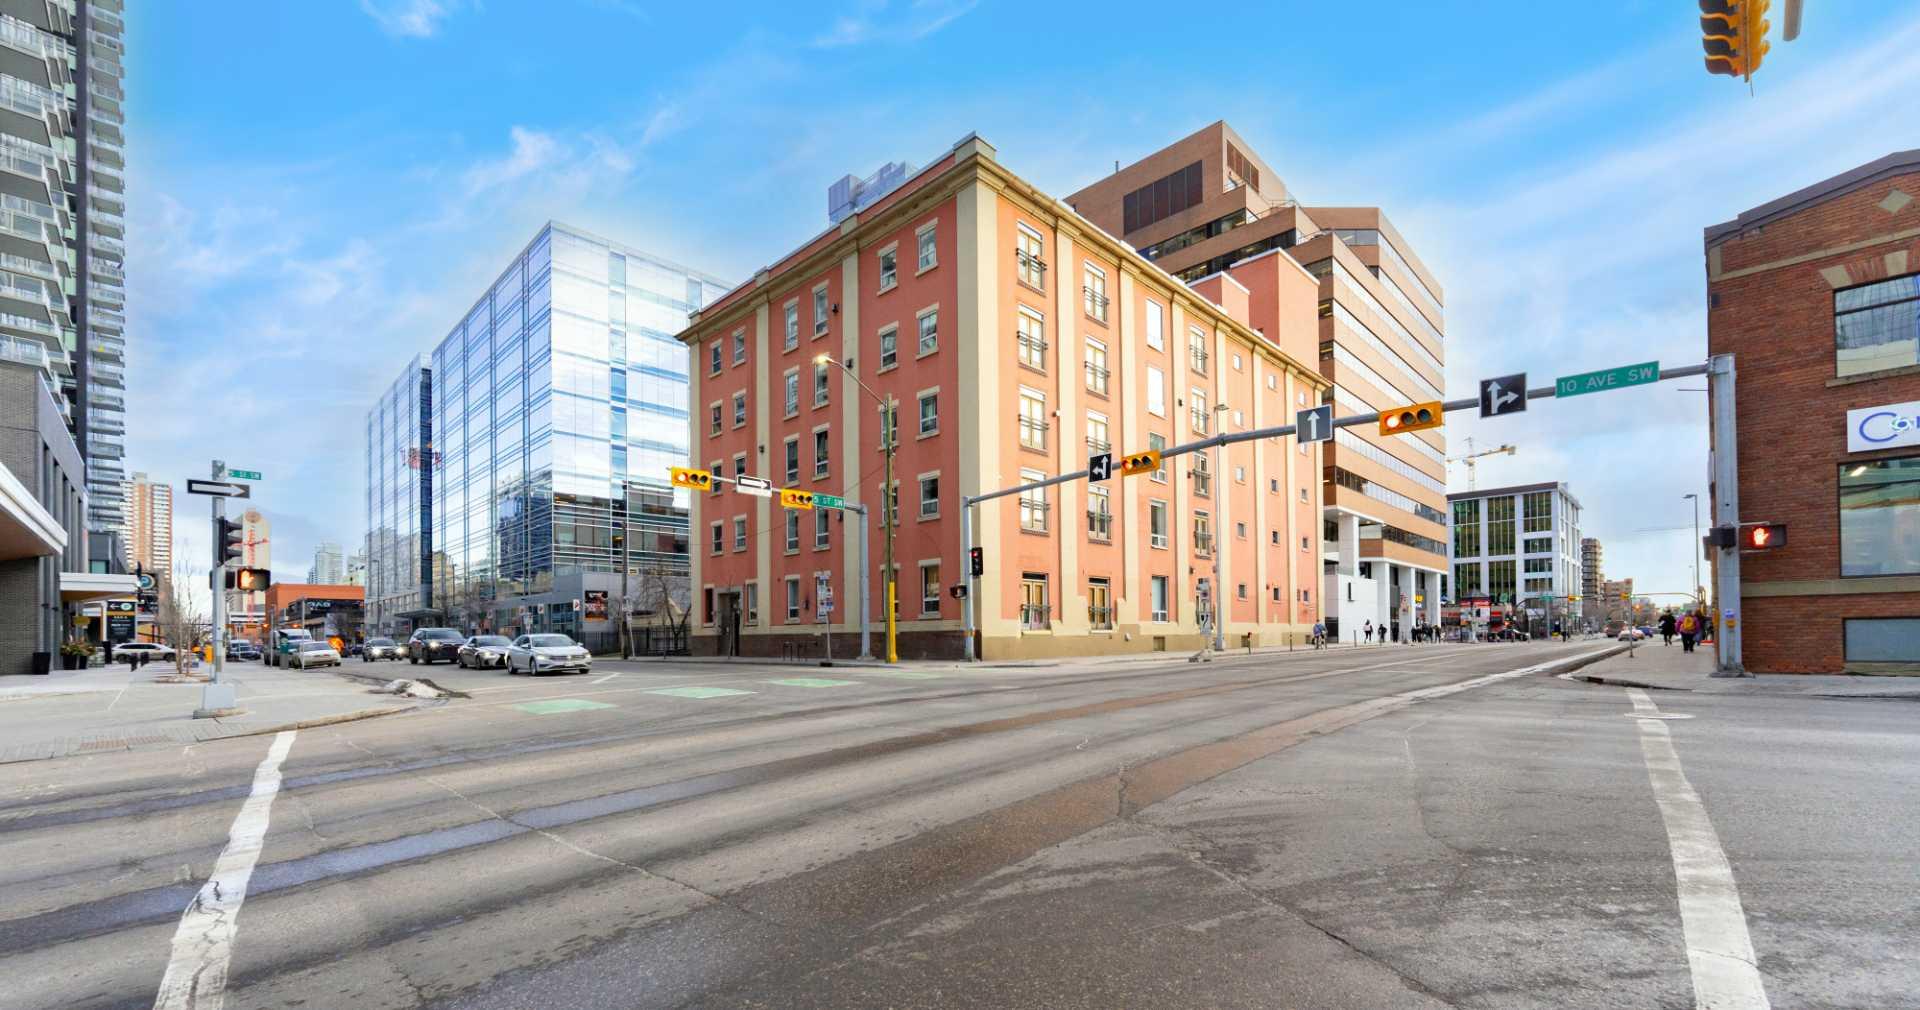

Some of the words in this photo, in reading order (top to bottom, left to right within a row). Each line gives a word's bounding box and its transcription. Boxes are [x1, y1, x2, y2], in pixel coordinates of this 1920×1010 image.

[1561, 380, 1577, 392] 10
[1586, 374, 1617, 389] AVE
[1628, 367, 1654, 381] SW
[834, 498, 843, 507] SW
